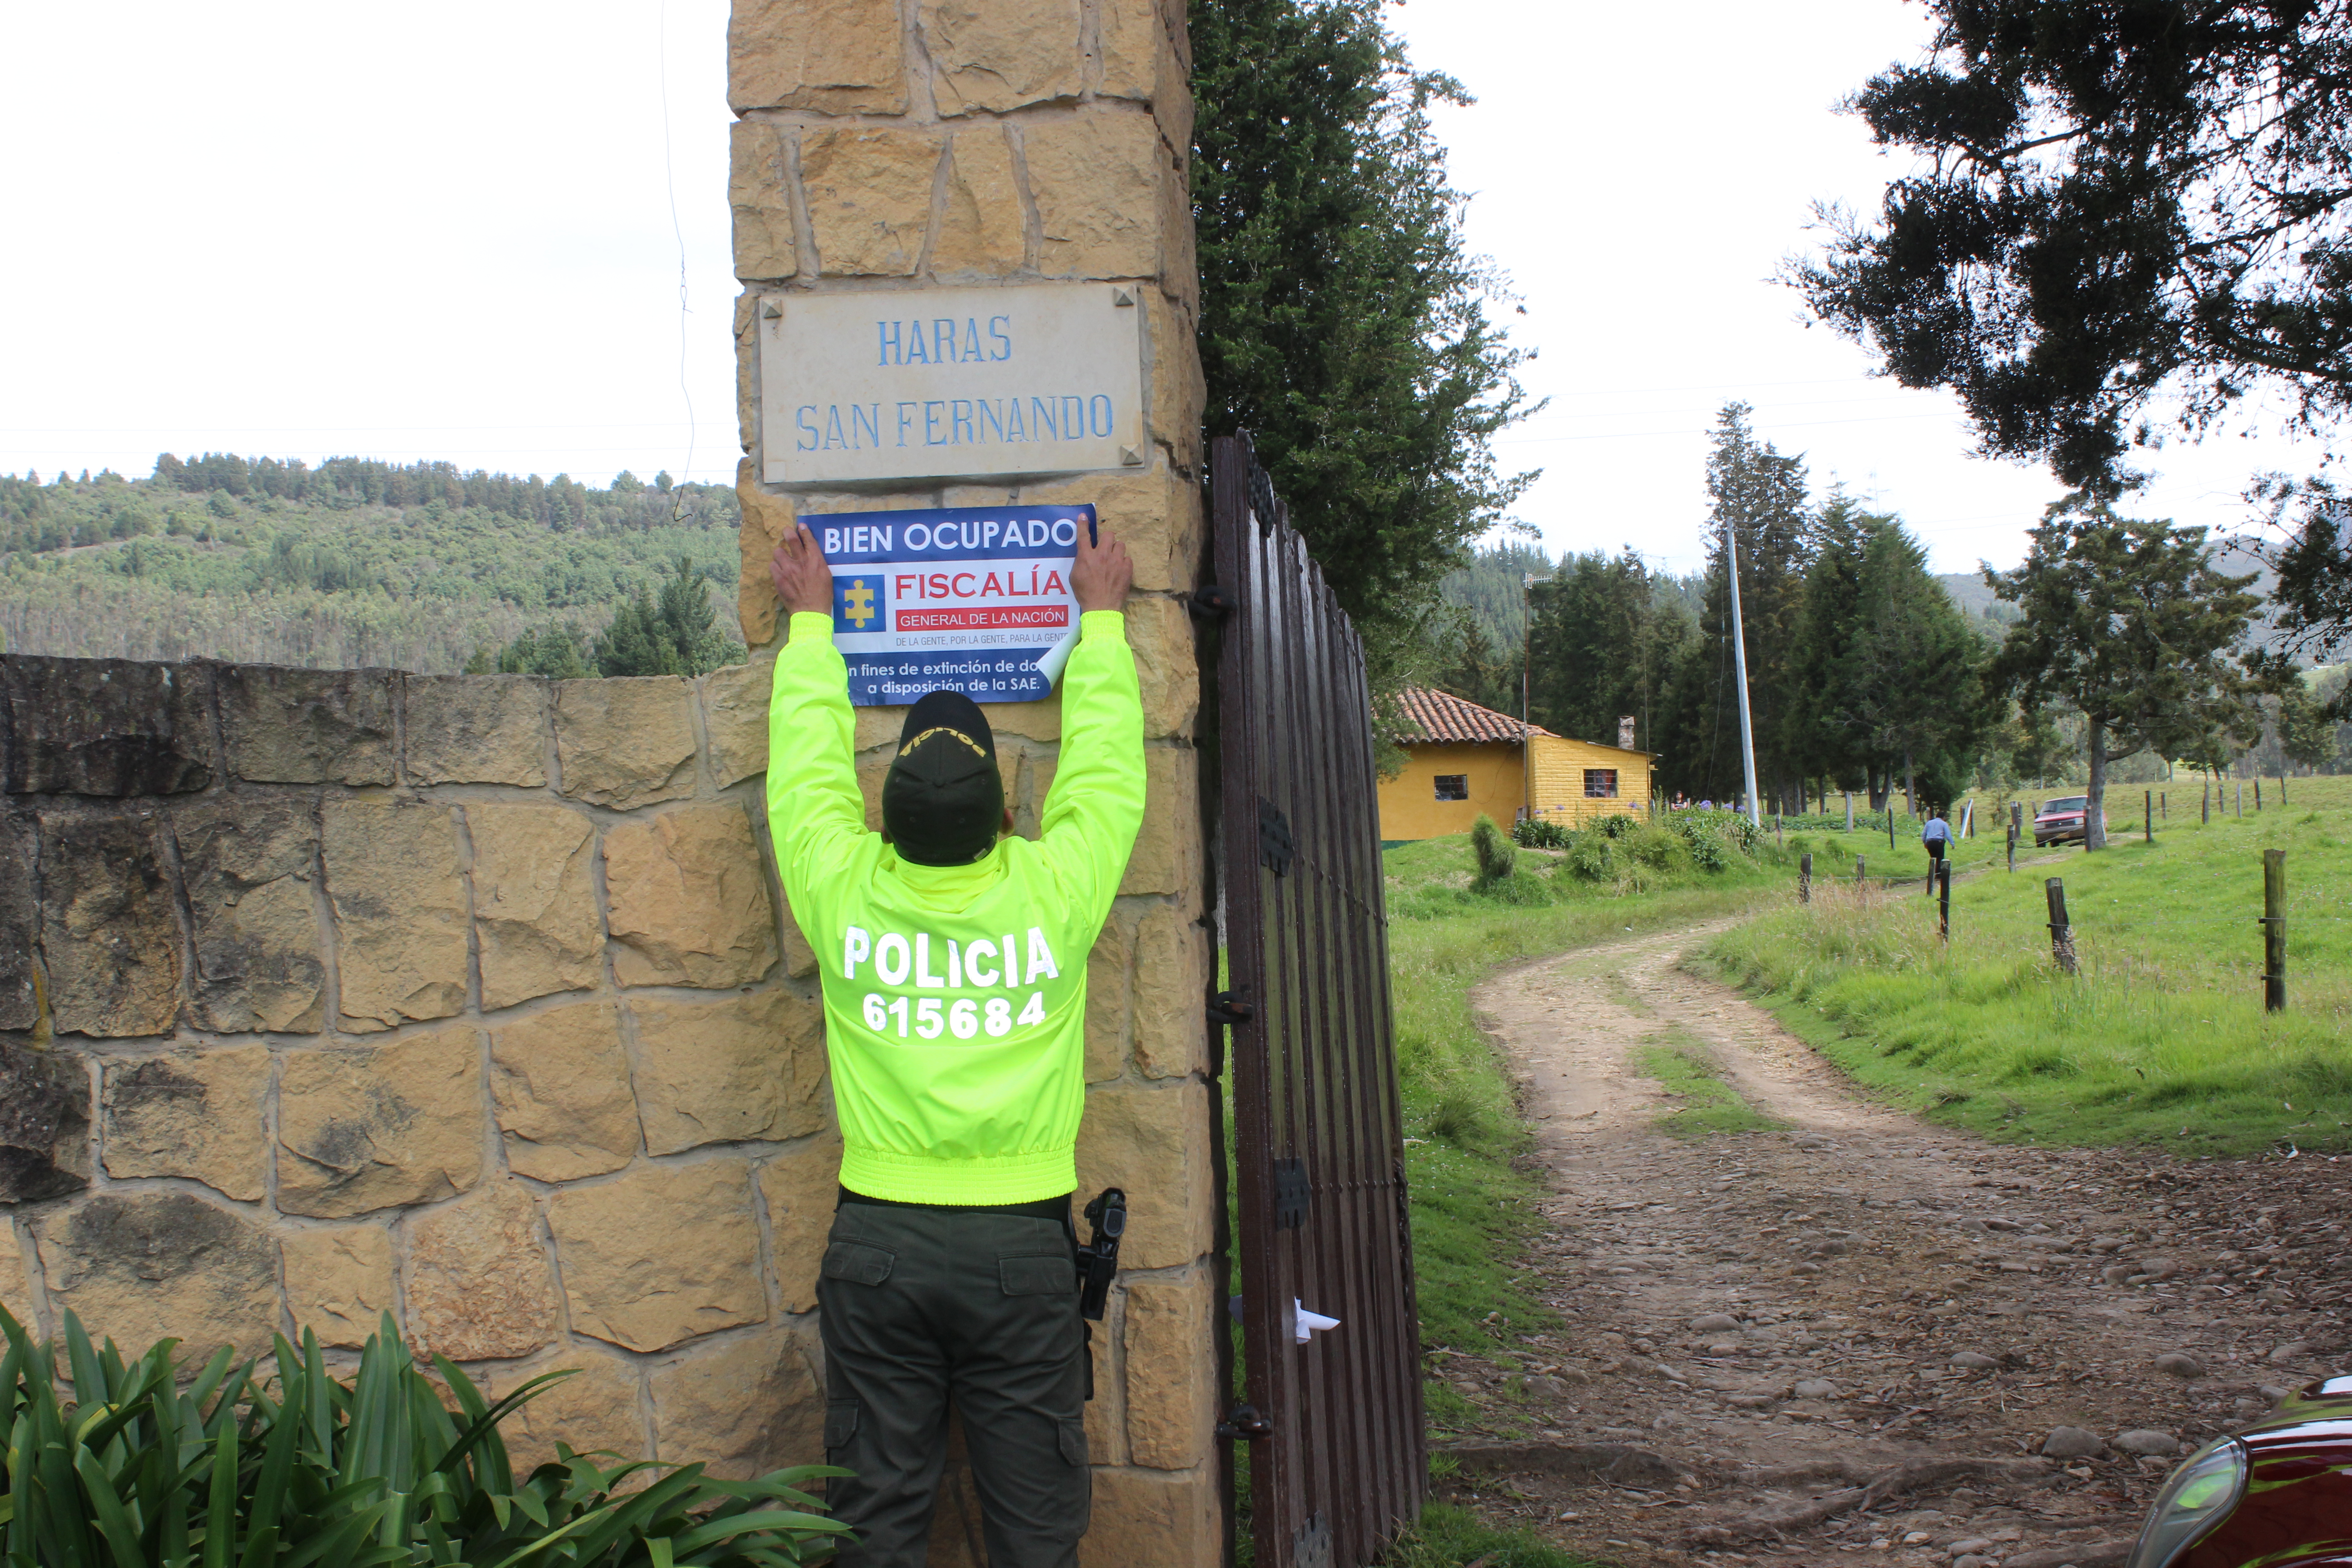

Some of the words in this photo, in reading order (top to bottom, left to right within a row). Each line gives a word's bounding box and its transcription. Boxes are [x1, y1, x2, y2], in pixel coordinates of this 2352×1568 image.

[877, 315, 1011, 366] HARAS
[796, 403, 880, 452] SAN
[895, 394, 1113, 448] FERNANDO
[824, 525, 892, 554] BIEN
[904, 519, 1077, 551] OCUPADO
[895, 564, 1068, 600] FISCALÍA
[900, 614, 965, 627] GENERAL
[970, 613, 988, 624] DE
[992, 612, 1009, 624] LA
[1012, 608, 1064, 623] NACIÓN
[896, 637, 906, 646] DE
[909, 637, 919, 646] LA
[921, 636, 948, 646] GENTE,
[951, 636, 966, 645] POR
[969, 635, 979, 644] LA
[981, 634, 1007, 644] GENTE,
[1010, 634, 1030, 643] PARA
[1033, 634, 1042, 642] LA
[861, 664, 895, 676] fines
[899, 663, 919, 676] de
[923, 659, 990, 675] extinción
[995, 660, 1015, 673] de
[867, 685, 877, 694] a
[882, 678, 964, 696] disposición
[969, 679, 988, 691] de
[993, 678, 1006, 691] la
[1010, 677, 1040, 691] SAE.
[899, 727, 986, 757] POLICIA
[844, 926, 1059, 988] POLICIA
[863, 991, 1045, 1039] 615684
